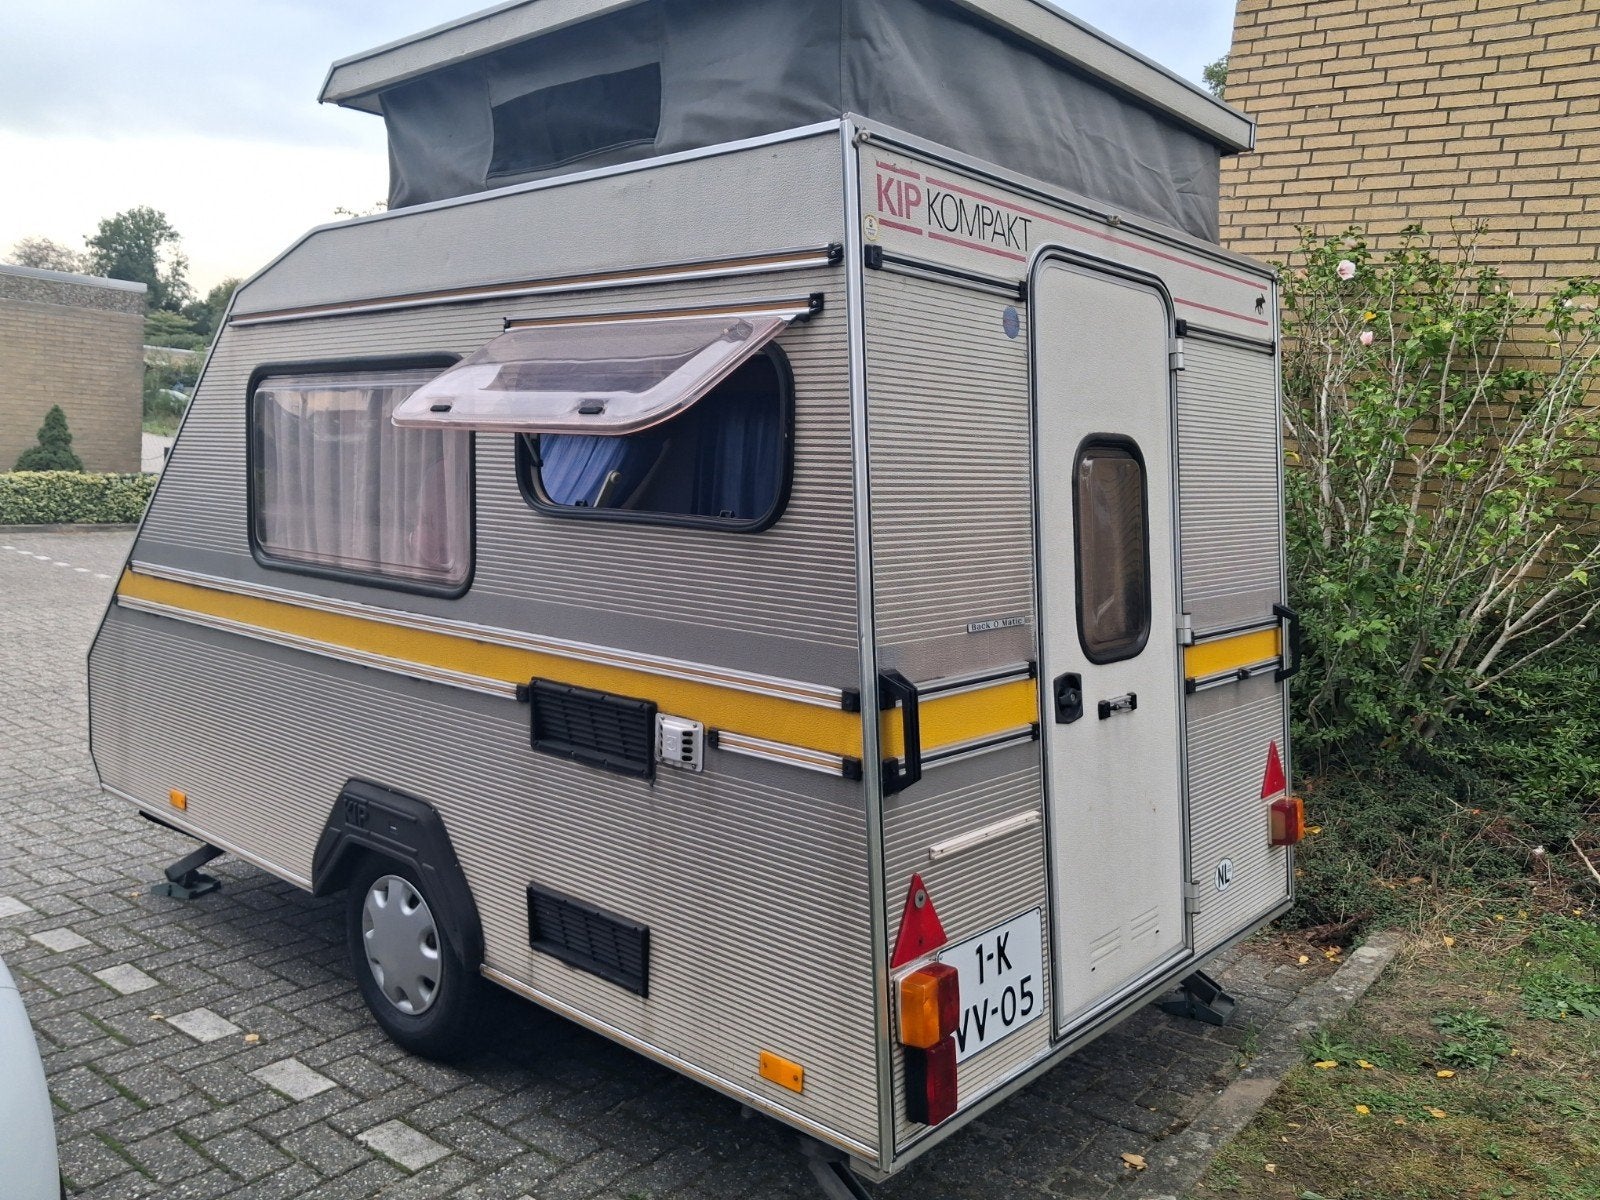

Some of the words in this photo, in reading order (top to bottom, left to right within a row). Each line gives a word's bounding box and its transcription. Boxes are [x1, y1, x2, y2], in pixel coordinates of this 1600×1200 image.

[876, 173, 922, 219] KIP
[927, 188, 1032, 252] KOMPAKT
[971, 621, 991, 631] Back
[1002, 617, 1023, 627] Matic
[344, 799, 369, 828] KIP
[1218, 863, 1230, 888] NL
[975, 931, 1012, 985] 1-K
